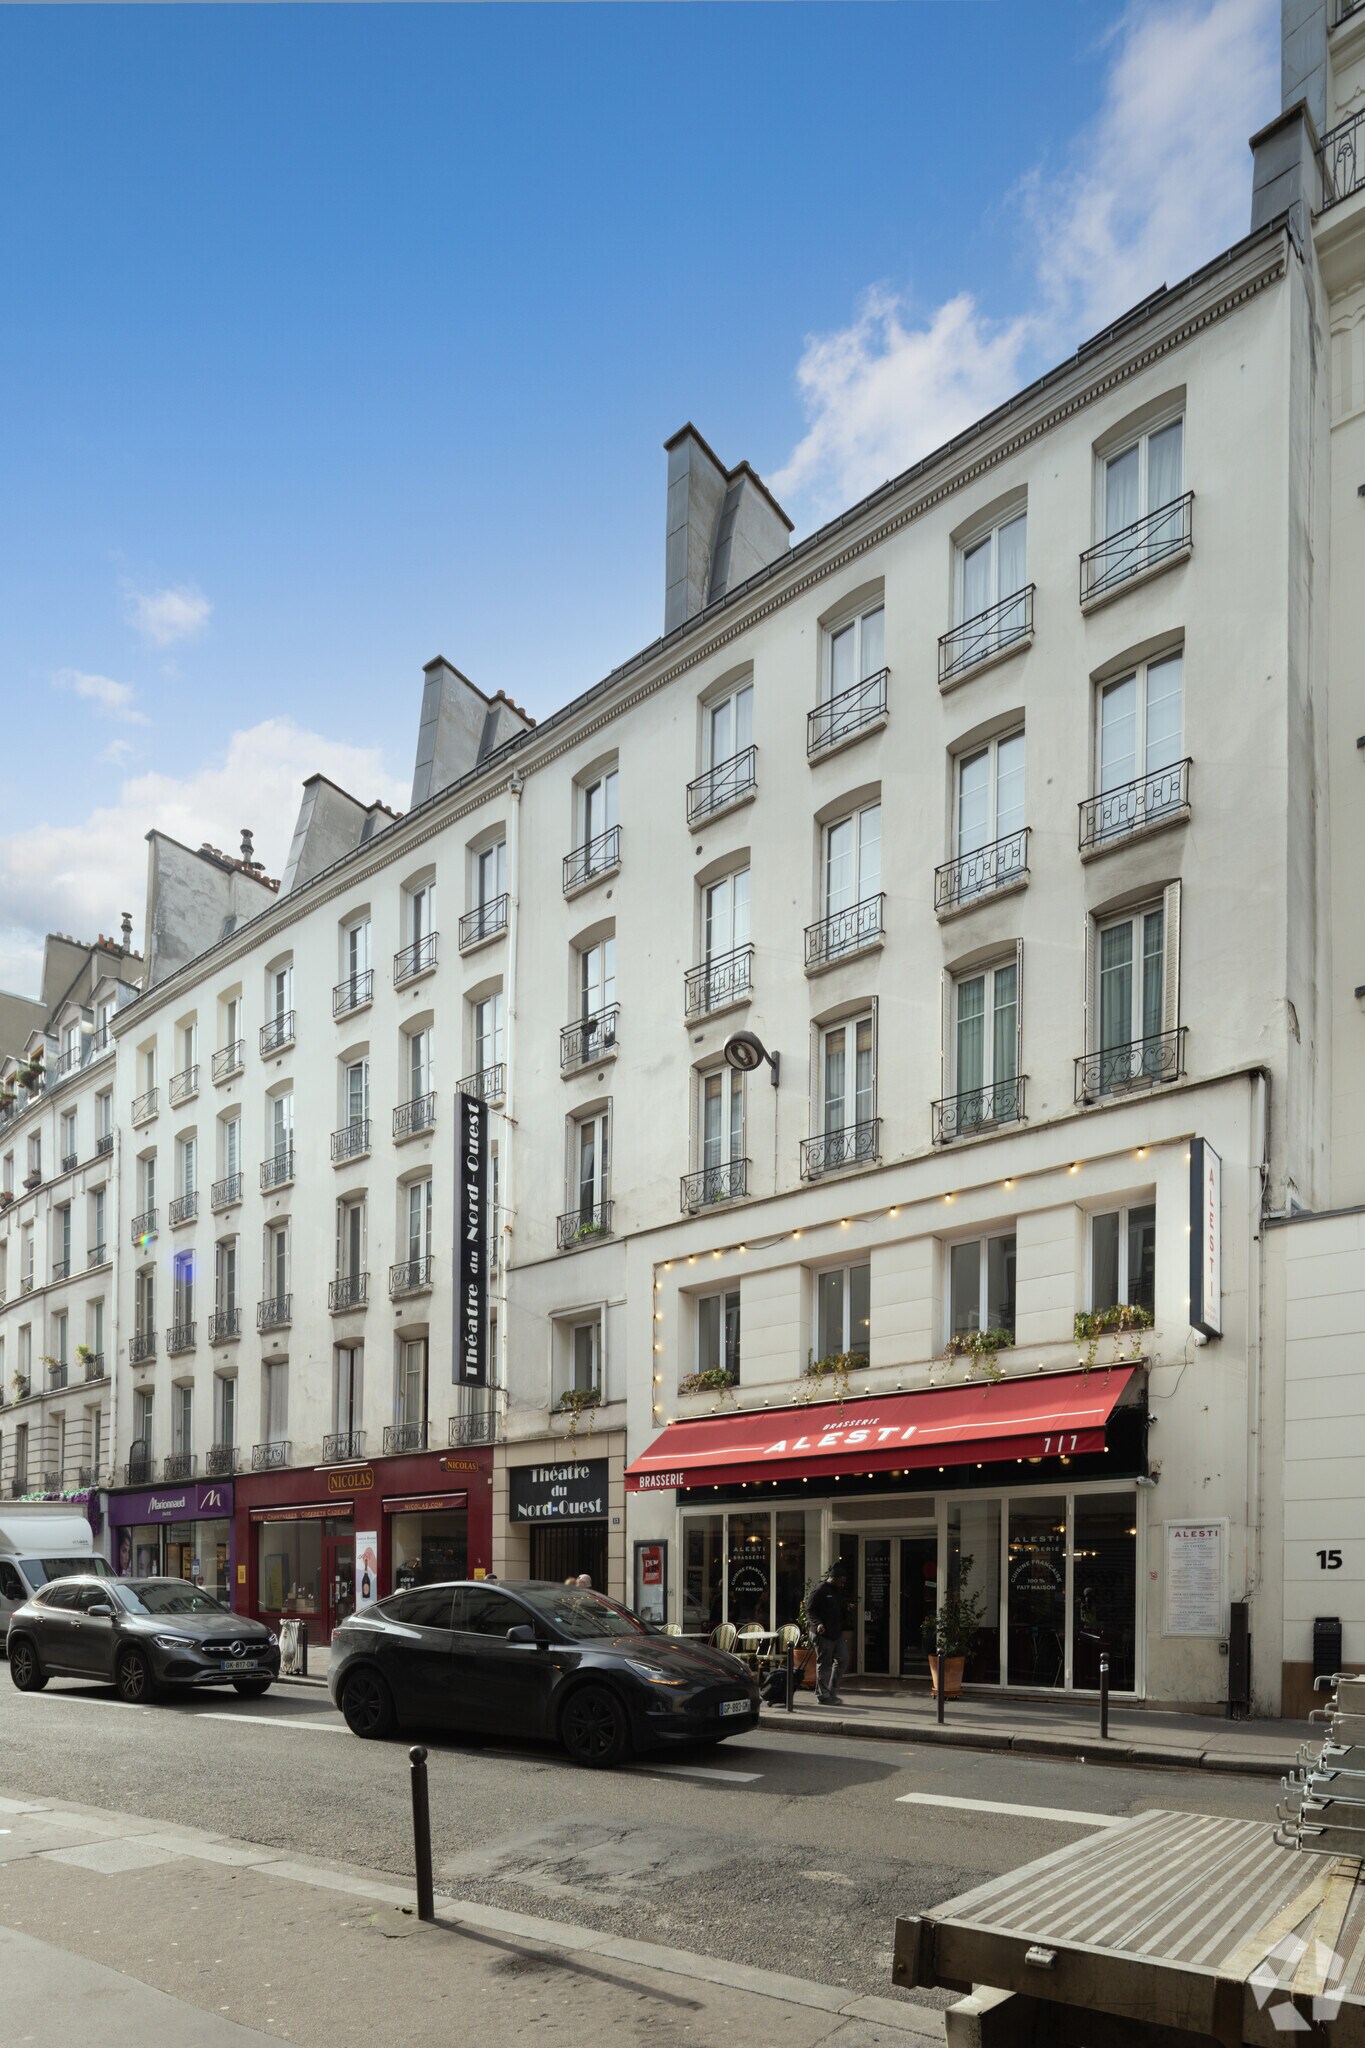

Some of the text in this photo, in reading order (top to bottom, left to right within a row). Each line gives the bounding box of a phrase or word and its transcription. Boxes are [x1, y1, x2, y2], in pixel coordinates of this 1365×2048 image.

[466, 1102, 479, 1242] Nord-Ouest
[469, 1250, 479, 1274] du
[822, 1417, 880, 1431] BRASSERIE
[763, 1426, 917, 1454] ALESTI
[447, 1461, 477, 1470] NICOLAS
[530, 1465, 590, 1483] Théâtre
[330, 1472, 372, 1489] NICOLAS
[639, 1473, 684, 1488] BRASSERIE
[551, 1485, 567, 1497] du
[148, 1496, 186, 1514] Marionnaud
[404, 1502, 443, 1510] NICOLAS.COM
[517, 1498, 602, 1518] Nord-Ouest
[1013, 1535, 1059, 1543] ALESTI
[1174, 1530, 1218, 1538] ALESTI
[1316, 1549, 1343, 1570] 15
[1010, 1560, 1031, 1583] CUISINE
